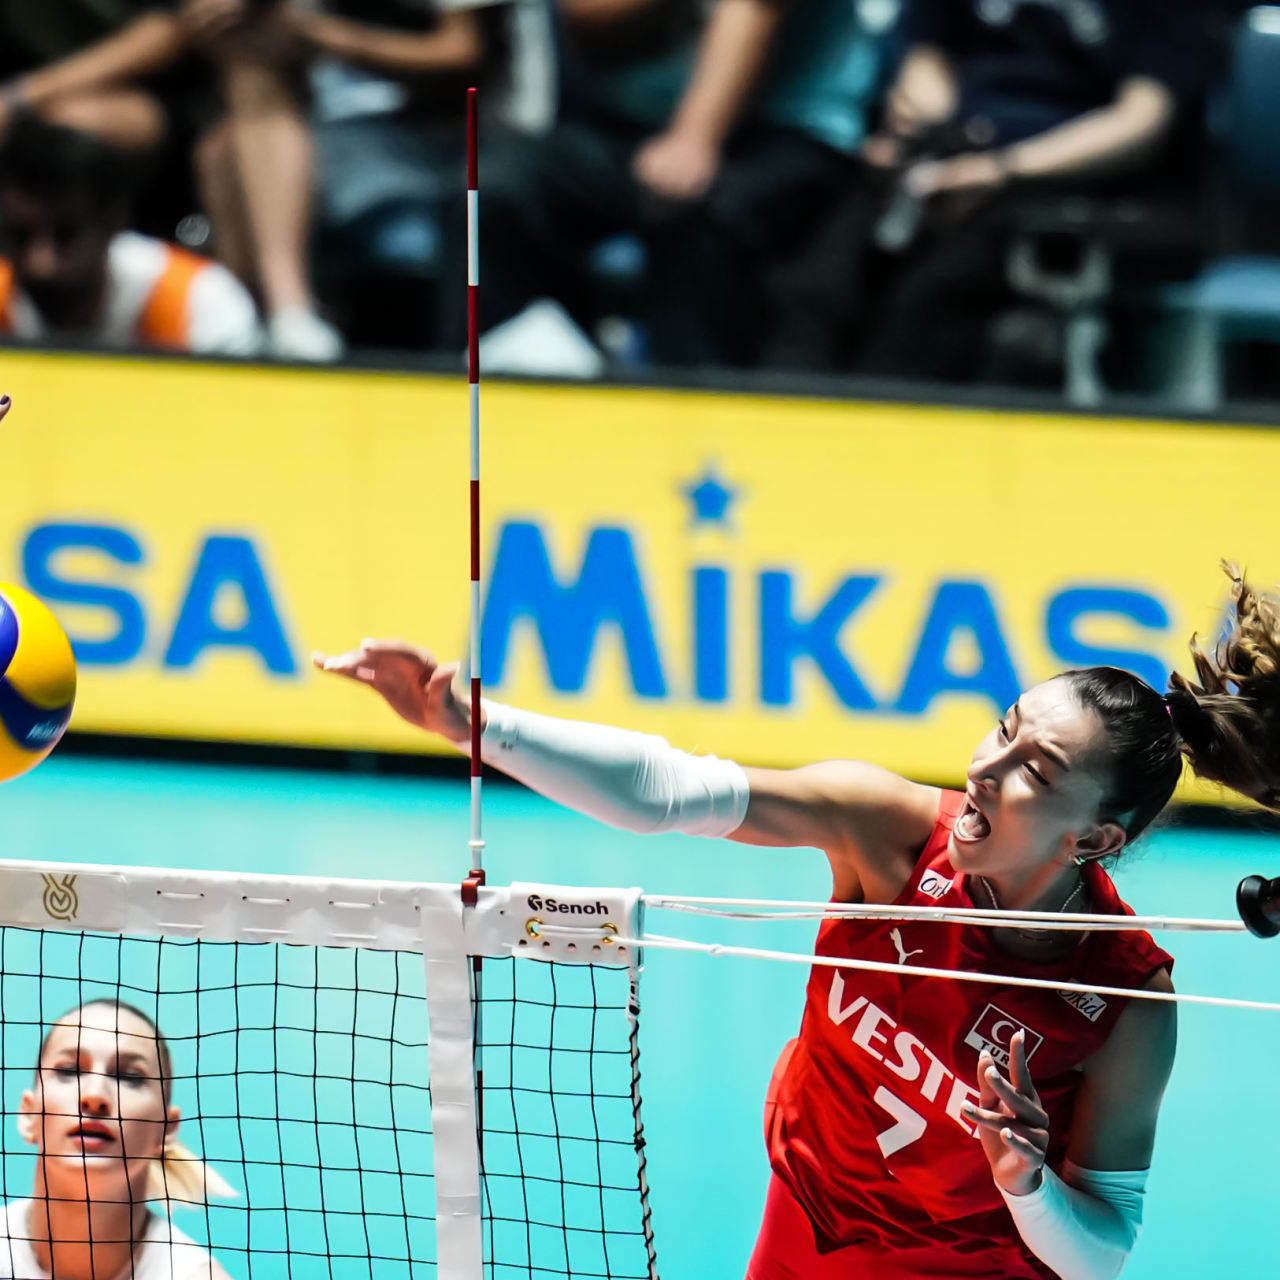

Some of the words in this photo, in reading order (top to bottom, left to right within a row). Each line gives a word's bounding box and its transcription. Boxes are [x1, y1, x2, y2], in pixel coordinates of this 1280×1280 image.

[545, 898, 609, 915] Senoh
[828, 968, 981, 1140] VESTE
[873, 1085, 928, 1160] 7
